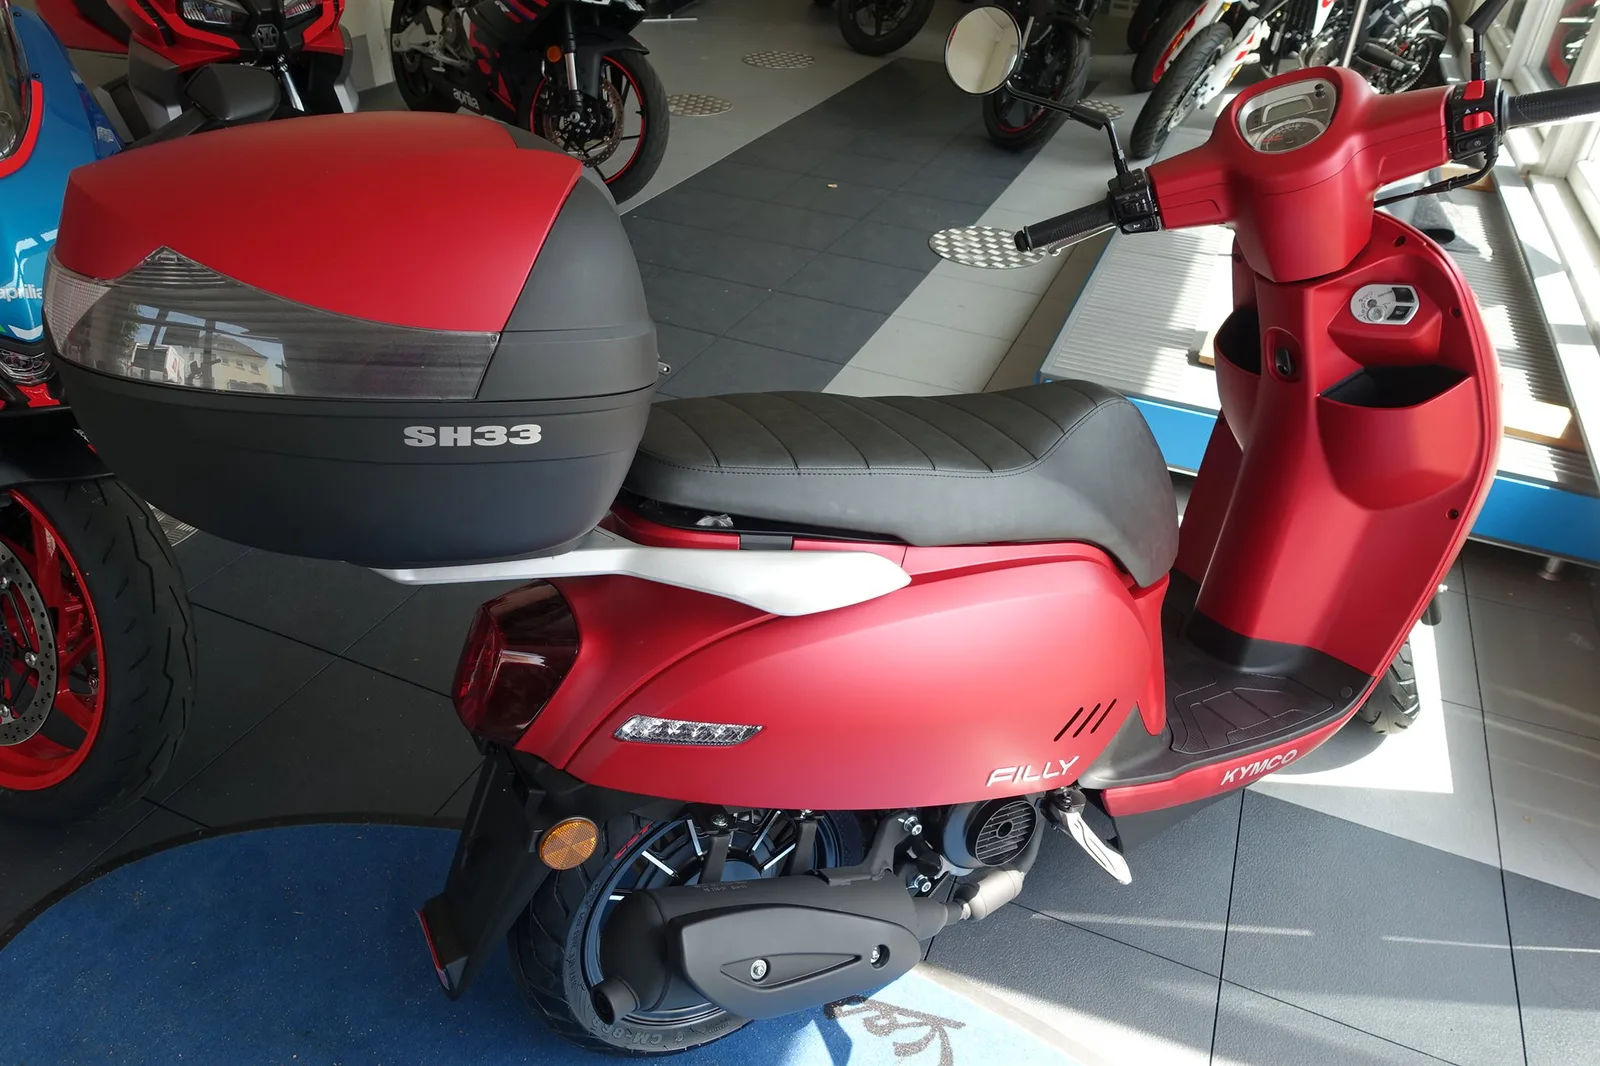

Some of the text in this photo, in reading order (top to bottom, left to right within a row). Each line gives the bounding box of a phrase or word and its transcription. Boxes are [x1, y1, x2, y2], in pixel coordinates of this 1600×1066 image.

[403, 423, 542, 447] SH33
[985, 755, 1079, 788] FILLY
[1220, 749, 1298, 786] KYMCO
